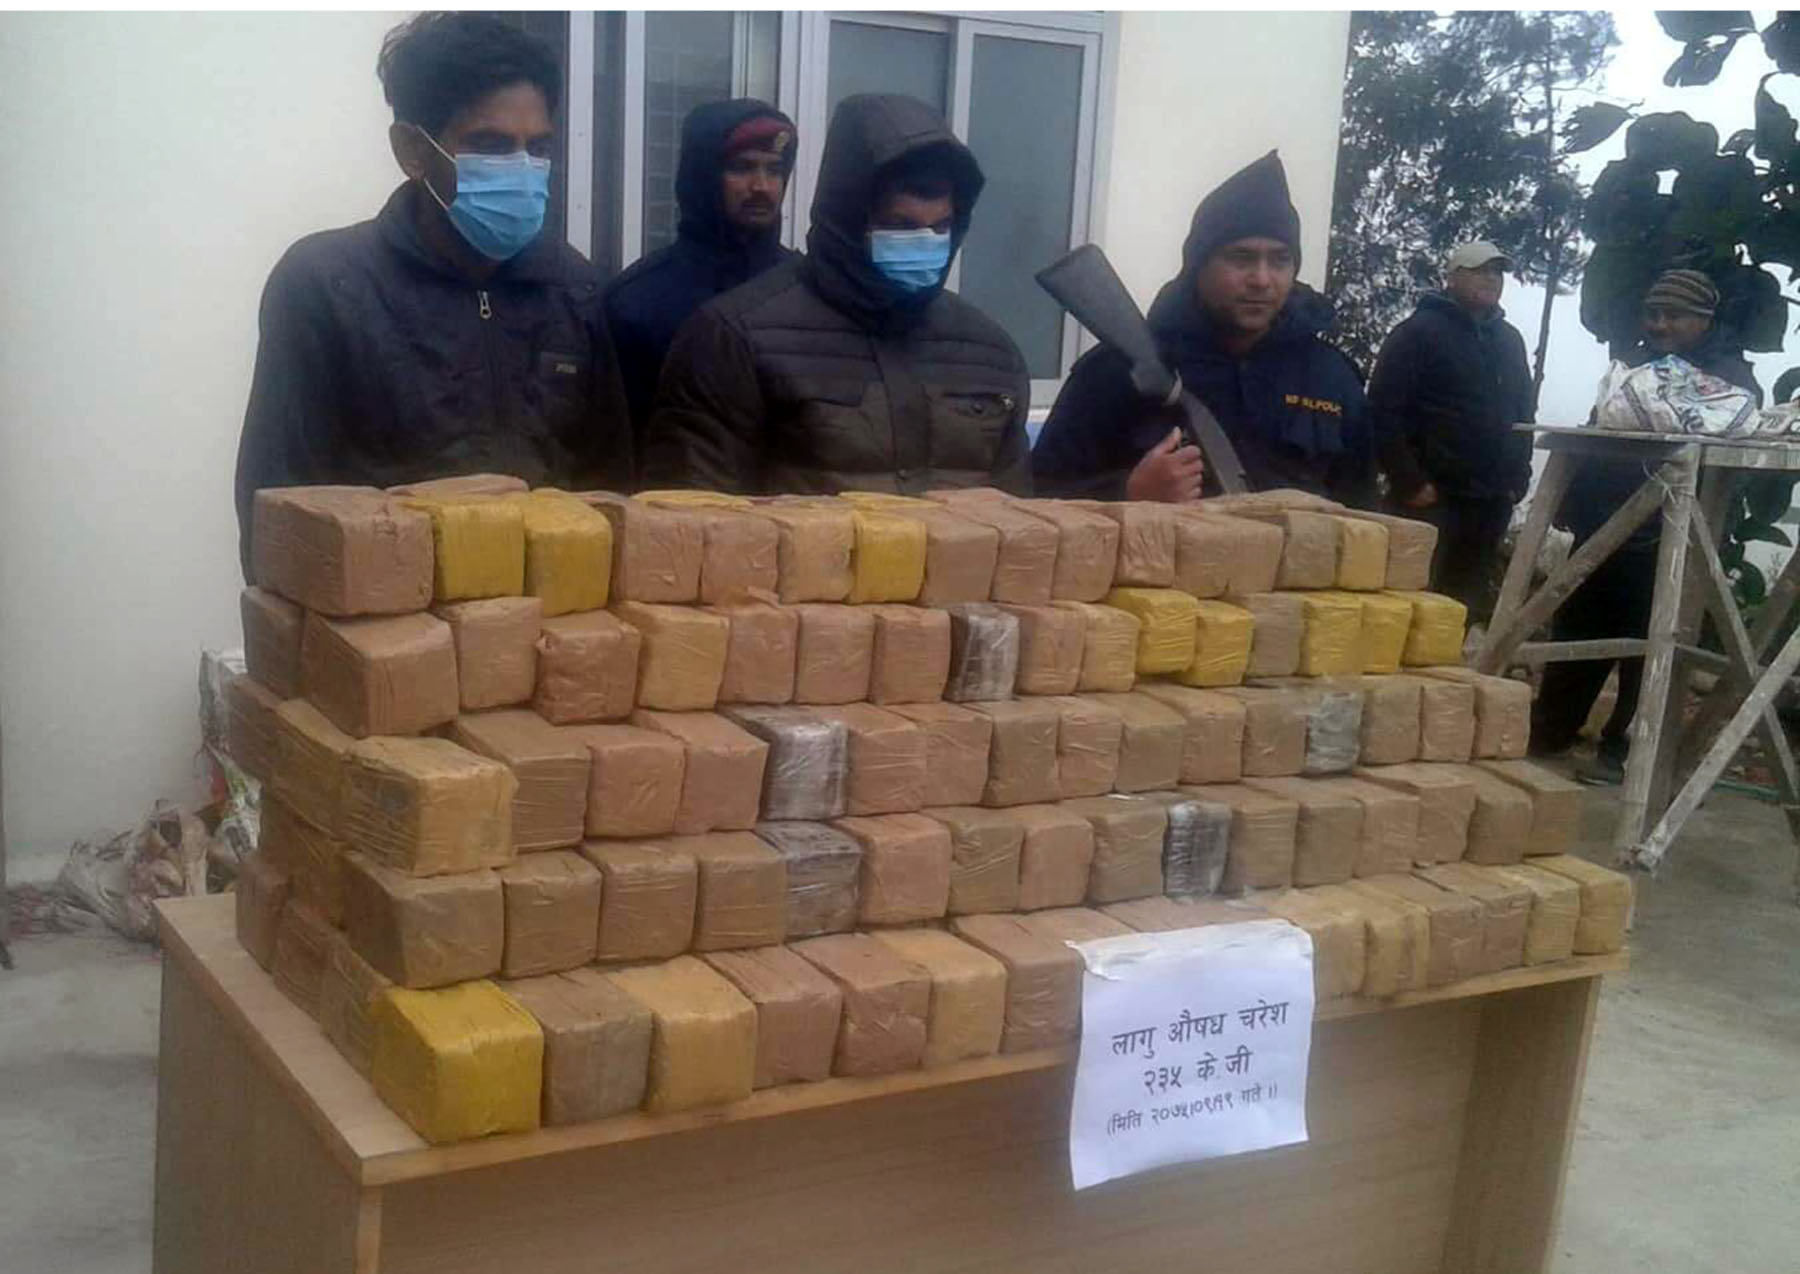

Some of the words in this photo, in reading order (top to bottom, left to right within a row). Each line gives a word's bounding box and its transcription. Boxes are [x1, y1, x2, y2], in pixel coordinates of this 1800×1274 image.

[1111, 1026, 1157, 1059] लागु
[1167, 1009, 1228, 1042] औषध
[1238, 999, 1289, 1030] चरेश
[1144, 1065, 1183, 1095] २३५
